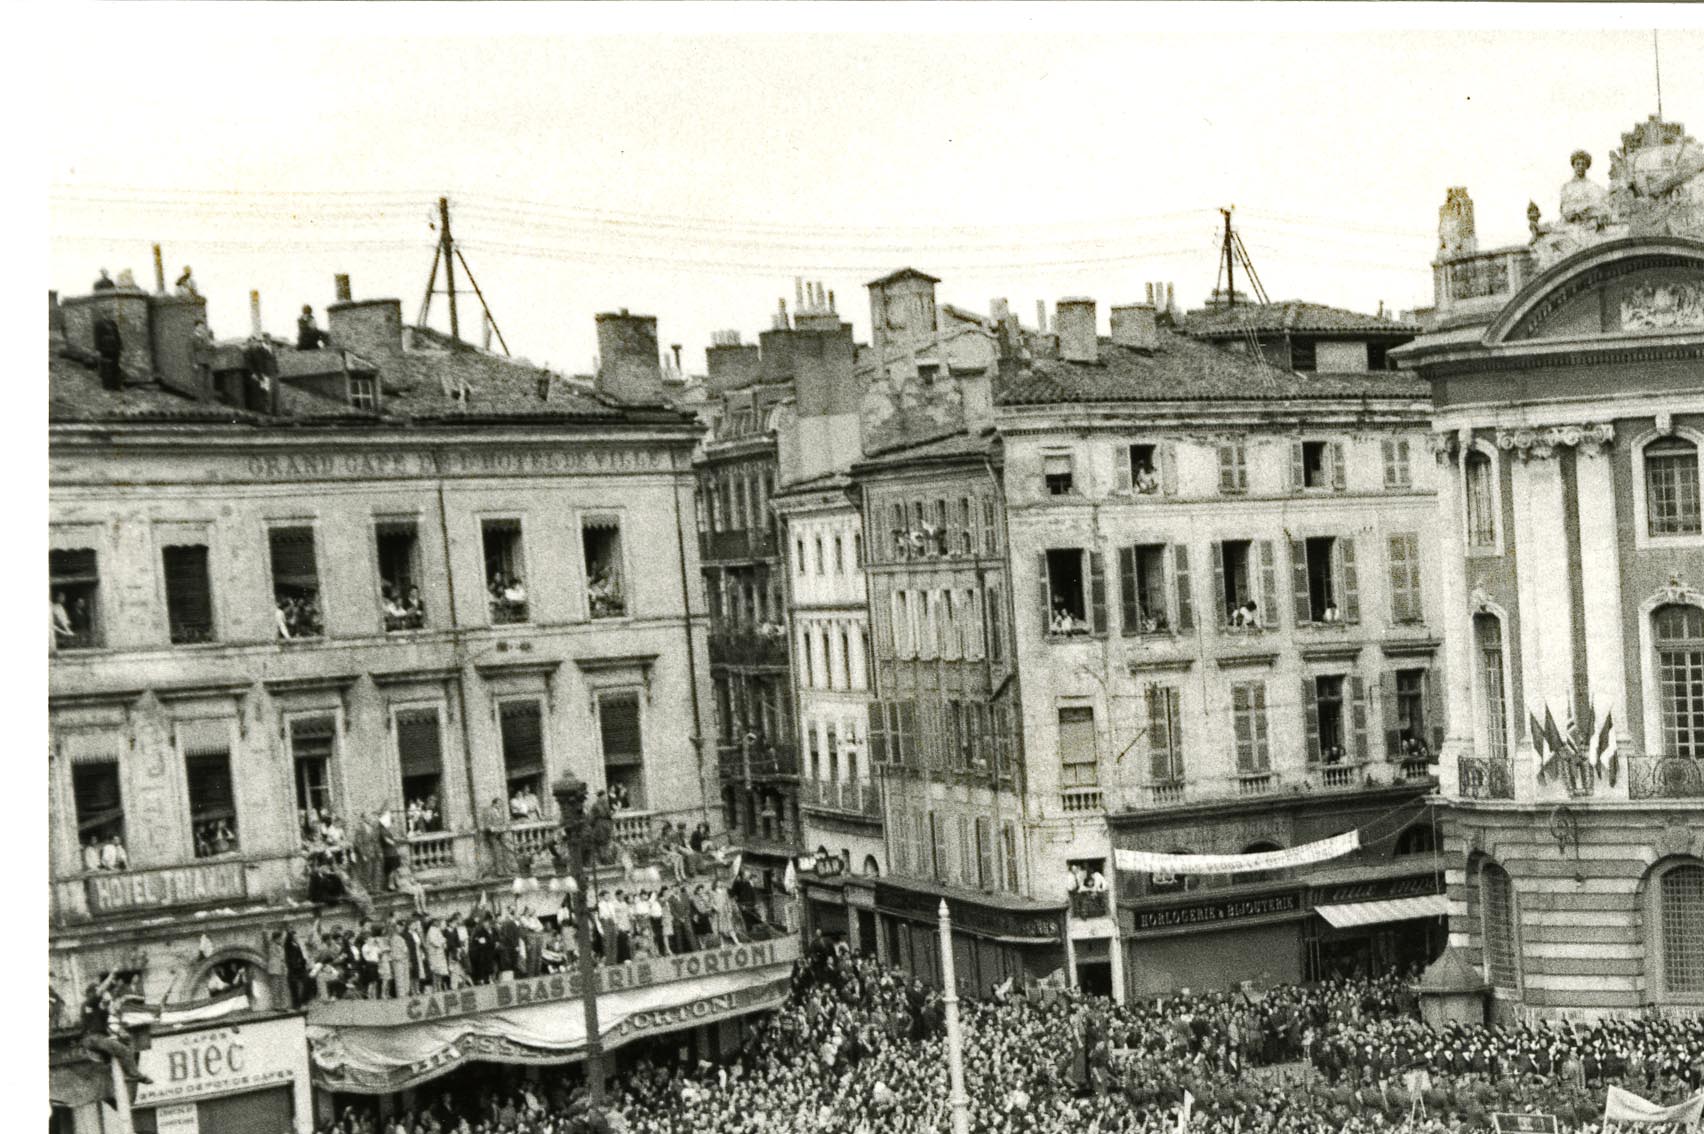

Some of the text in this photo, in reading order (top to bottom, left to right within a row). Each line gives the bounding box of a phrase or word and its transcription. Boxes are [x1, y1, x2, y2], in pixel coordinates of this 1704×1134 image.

[250, 454, 334, 479] GRAND
[96, 874, 157, 911] HOTEL
[1140, 906, 1216, 928] HORLOGERIE
[1227, 896, 1294, 917] BIJOUTERIE
[498, 962, 652, 1005] BRASSRIE
[671, 943, 775, 977] TORTONI
[618, 993, 737, 1037] TORTONI
[139, 1086, 183, 1101] GRAND
